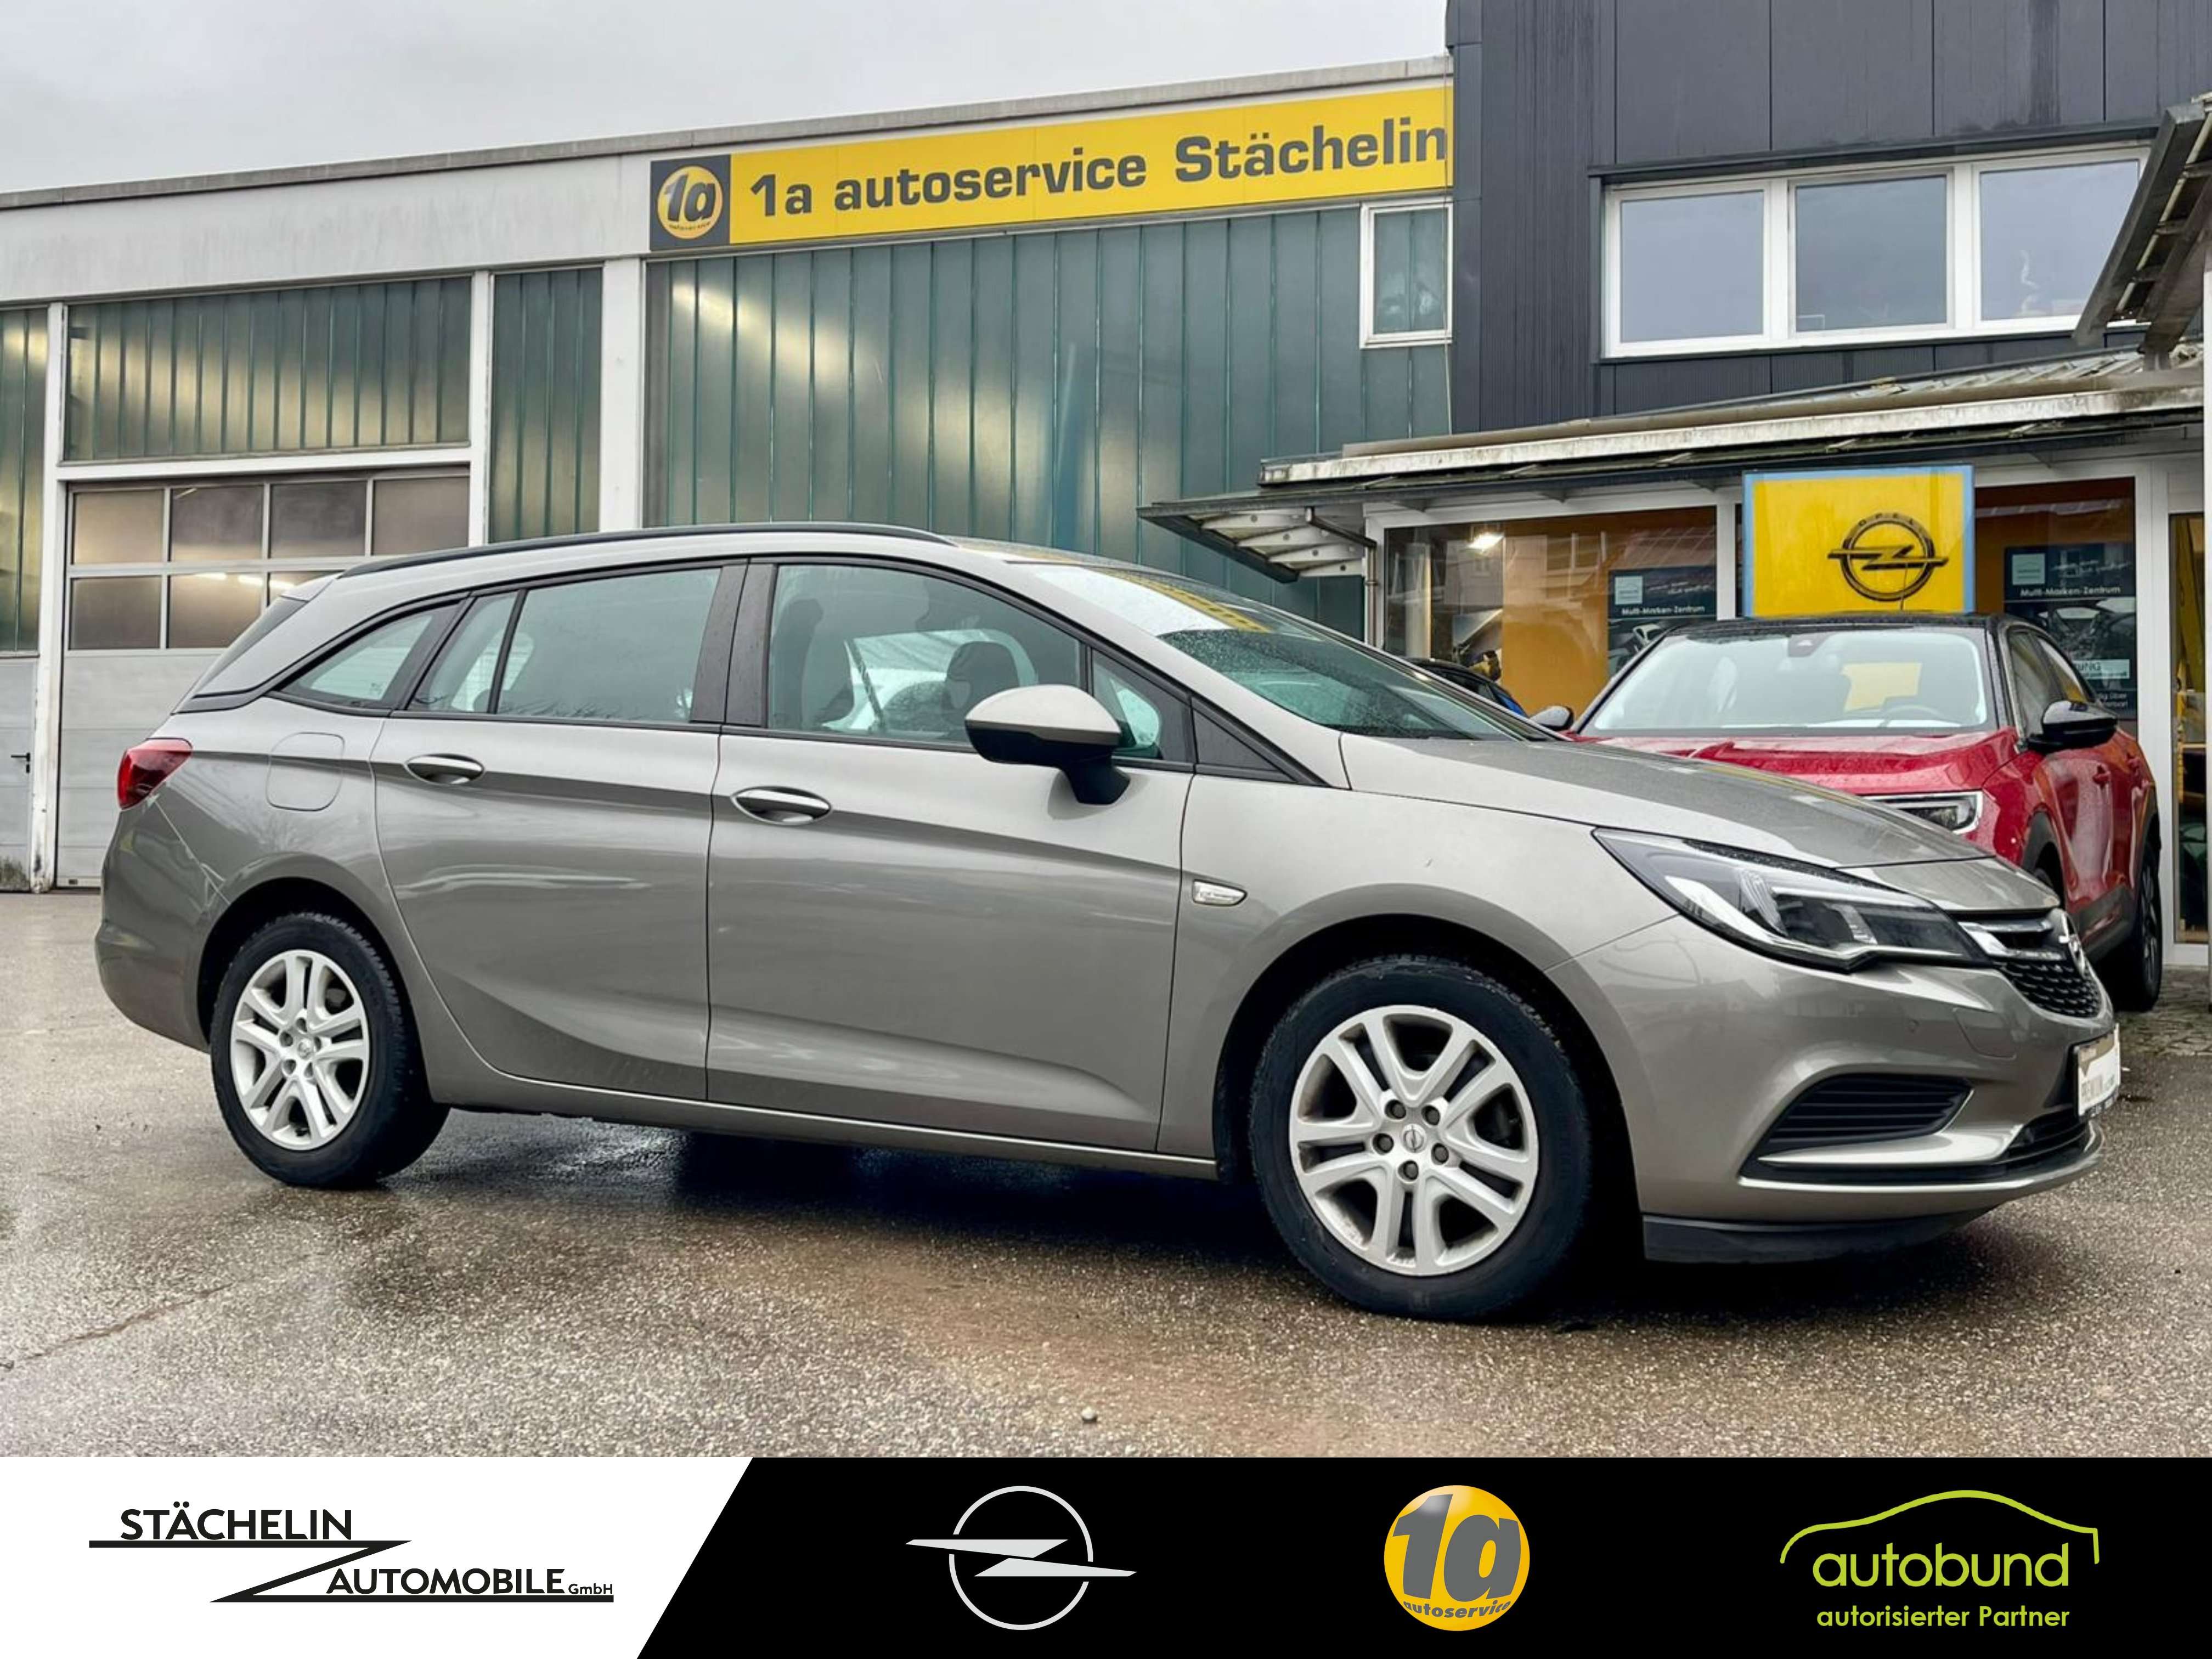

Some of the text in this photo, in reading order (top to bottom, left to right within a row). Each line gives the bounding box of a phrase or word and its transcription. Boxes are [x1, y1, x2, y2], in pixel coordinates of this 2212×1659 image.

[664, 174, 716, 222] 1a
[749, 117, 1447, 217] 1a autoservice Stächelin
